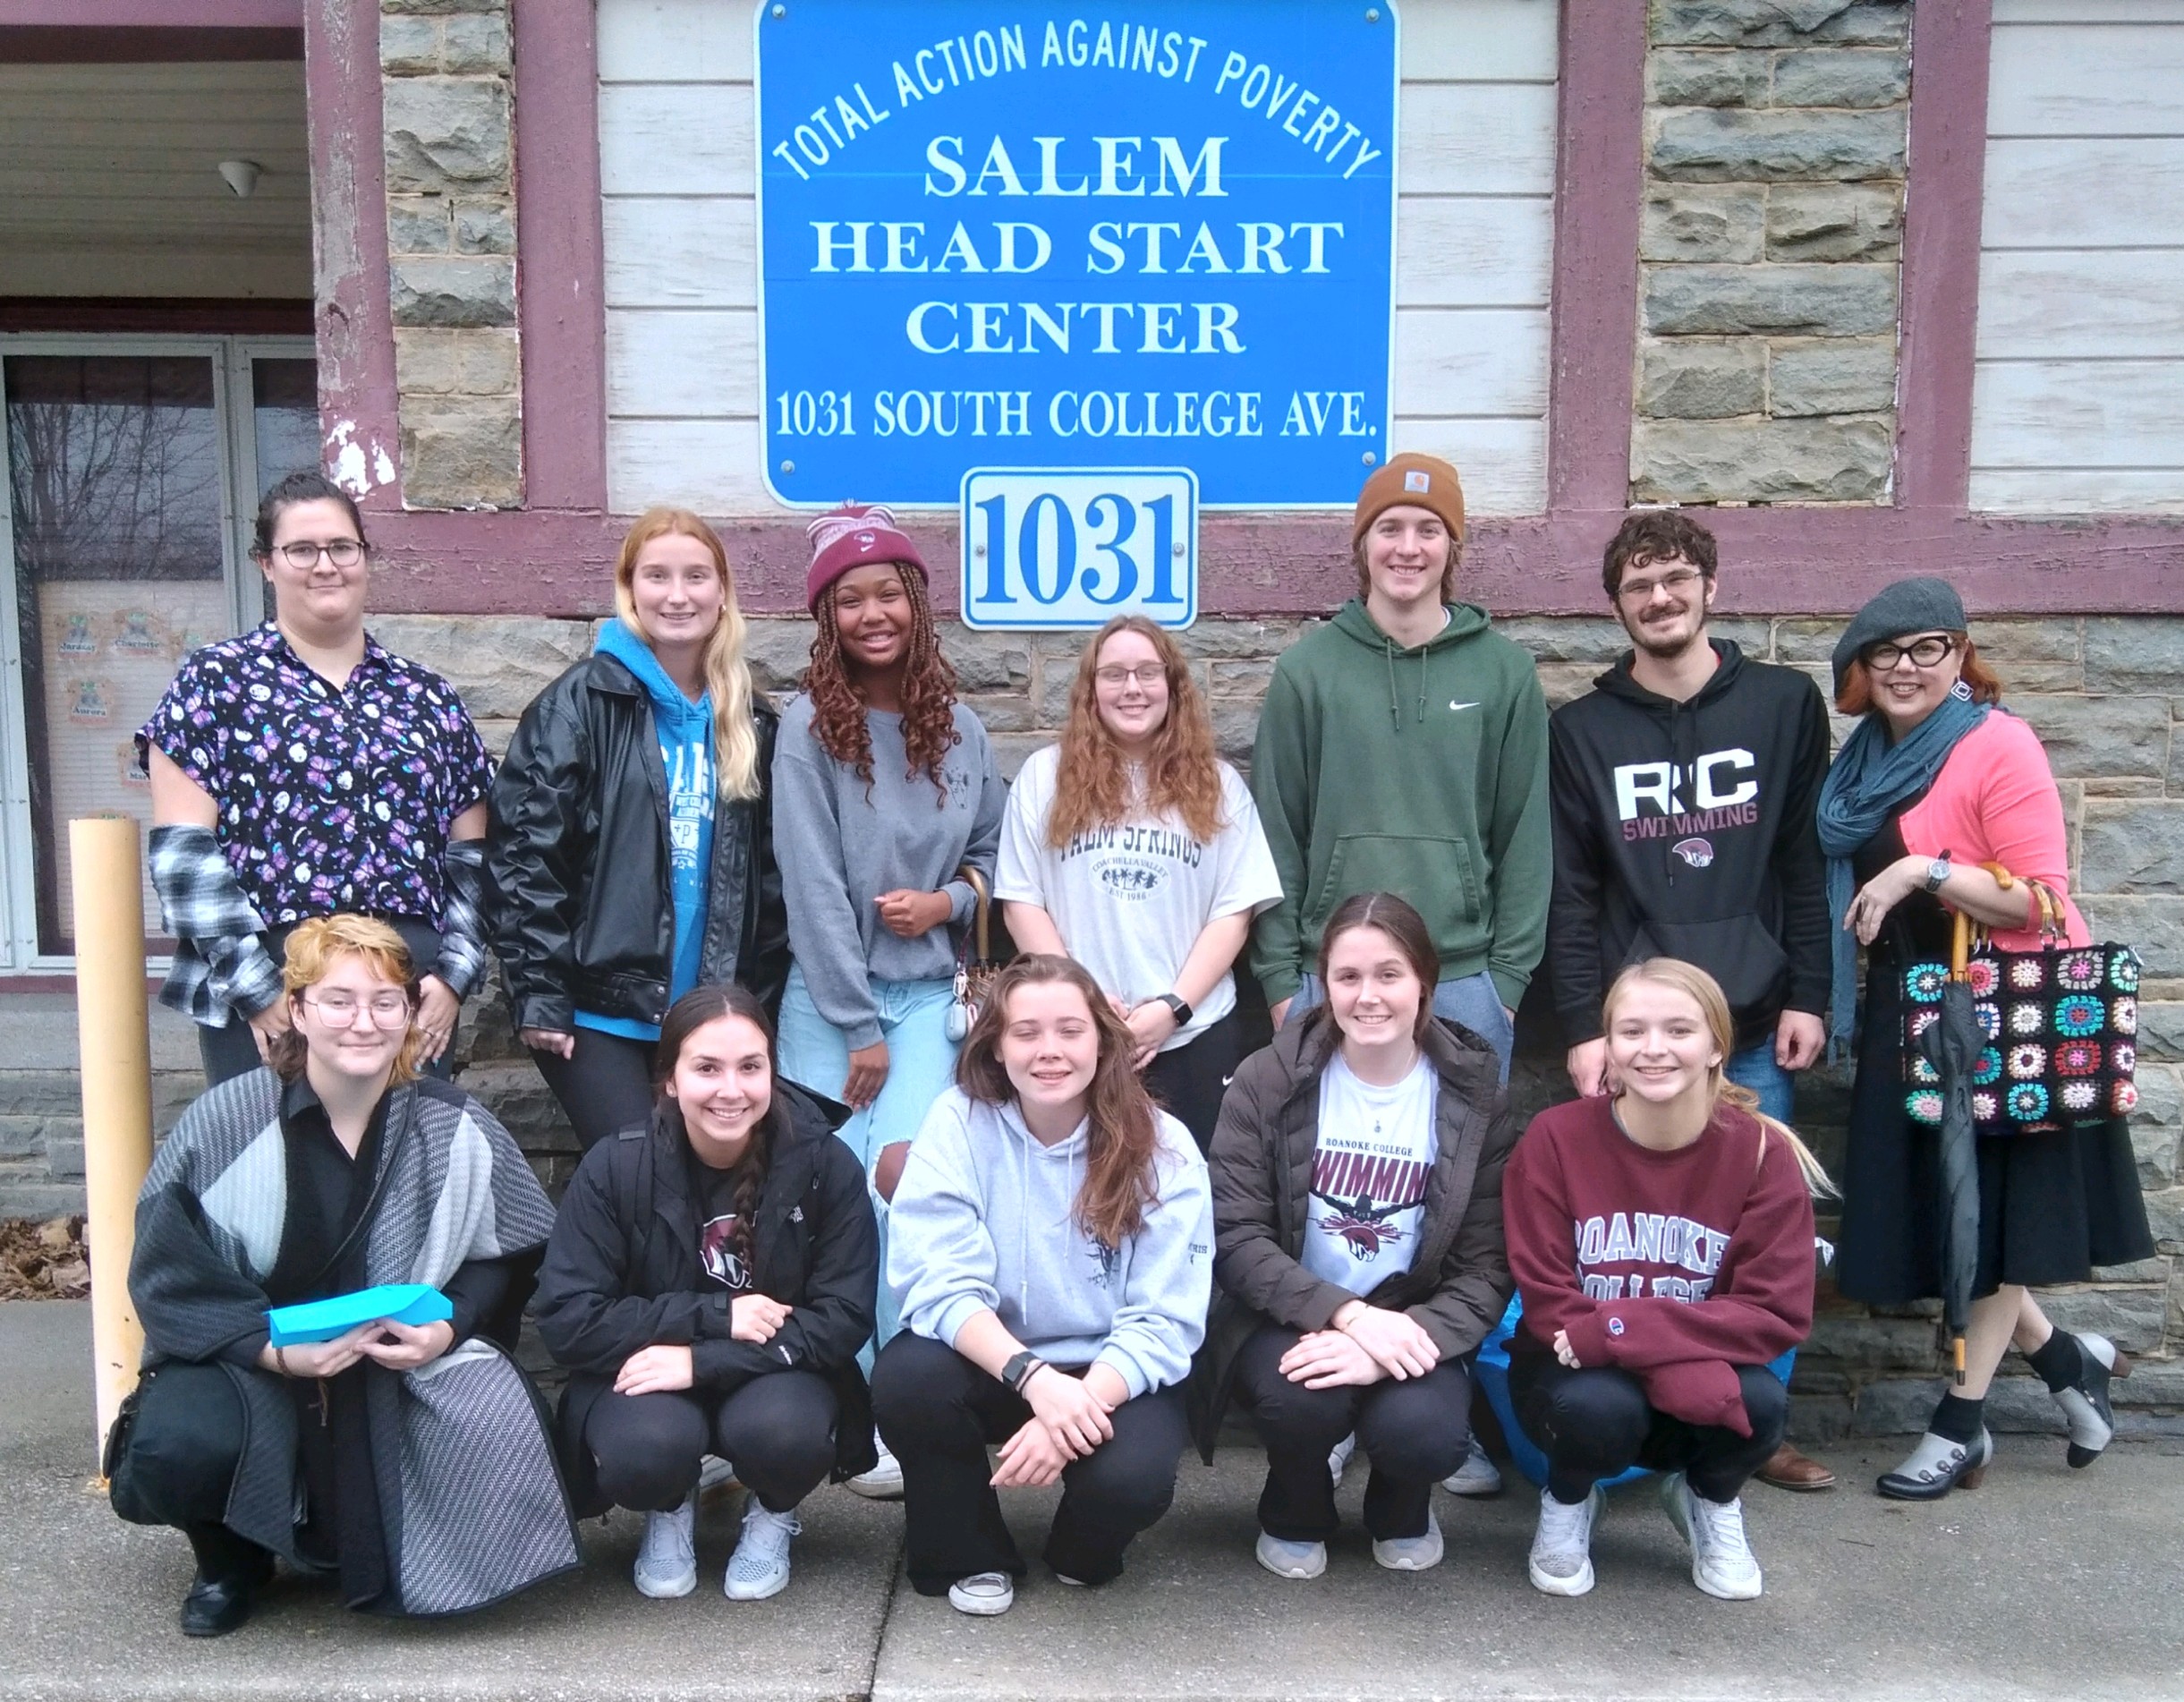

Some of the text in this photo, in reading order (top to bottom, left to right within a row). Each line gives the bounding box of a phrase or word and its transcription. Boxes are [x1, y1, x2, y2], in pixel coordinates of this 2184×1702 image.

[772, 19, 1381, 181] TOTAL ACTION AGAINST POVERTY
[925, 134, 1229, 197] SALEM
[810, 221, 1344, 273] HEAD START
[906, 302, 1246, 354] CENTER
[777, 390, 1378, 437] 1031 SOUTH COLLEGE AVE.
[974, 492, 1185, 606] 1031
[73, 705, 106, 716] Aurora
[1614, 748, 1758, 821] RC
[1623, 802, 1758, 841] SWIMMING
[1326, 1137, 1413, 1157] ROANOKE COLLEGE
[1575, 1212, 1731, 1276] OANOKE
